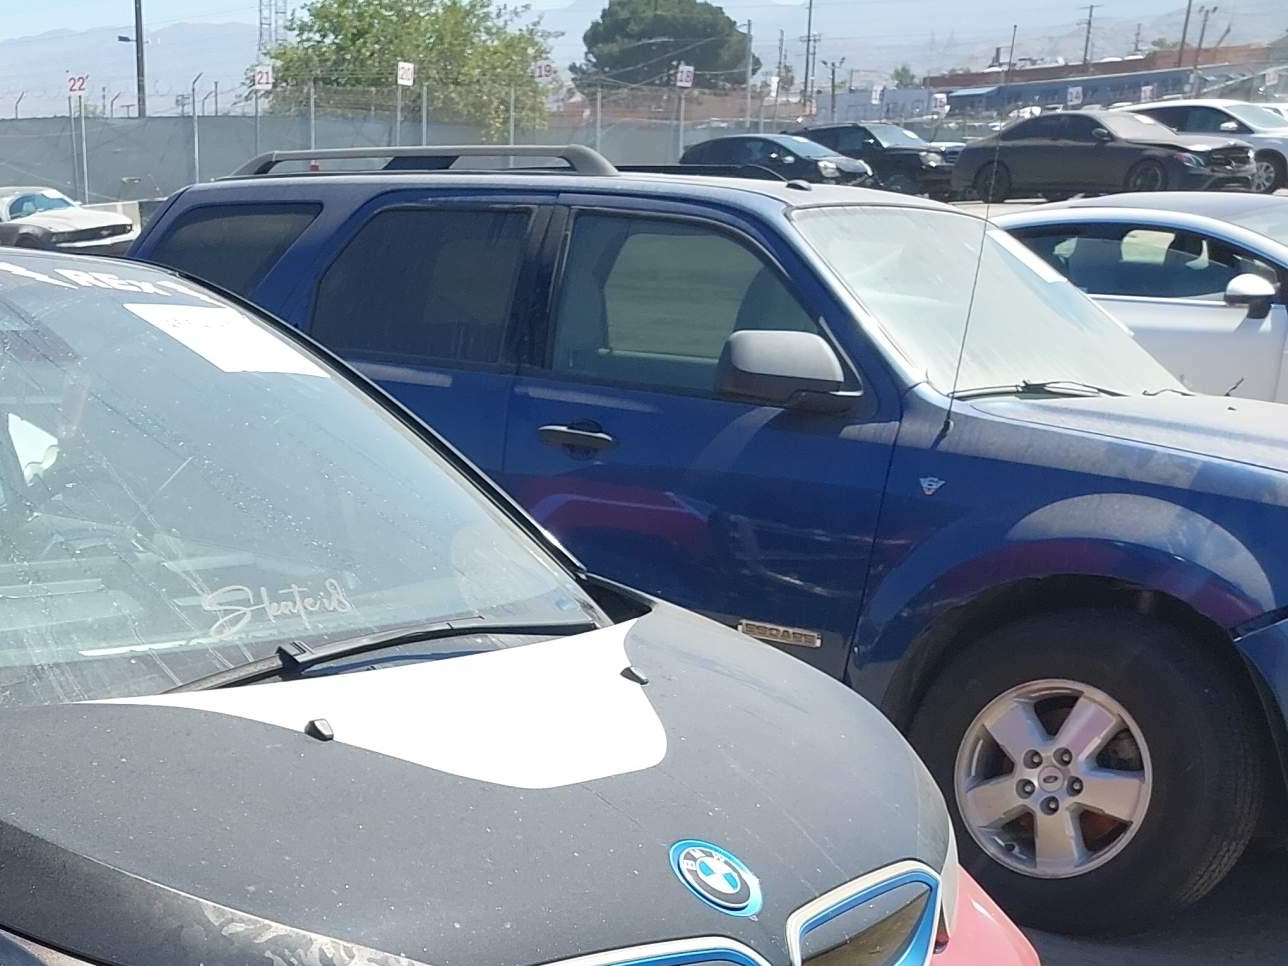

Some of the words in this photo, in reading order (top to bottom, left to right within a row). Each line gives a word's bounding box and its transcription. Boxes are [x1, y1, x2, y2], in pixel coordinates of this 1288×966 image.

[68, 76, 86, 92] 22
[256, 71, 271, 85] 21
[744, 622, 818, 645] ESCAPE
